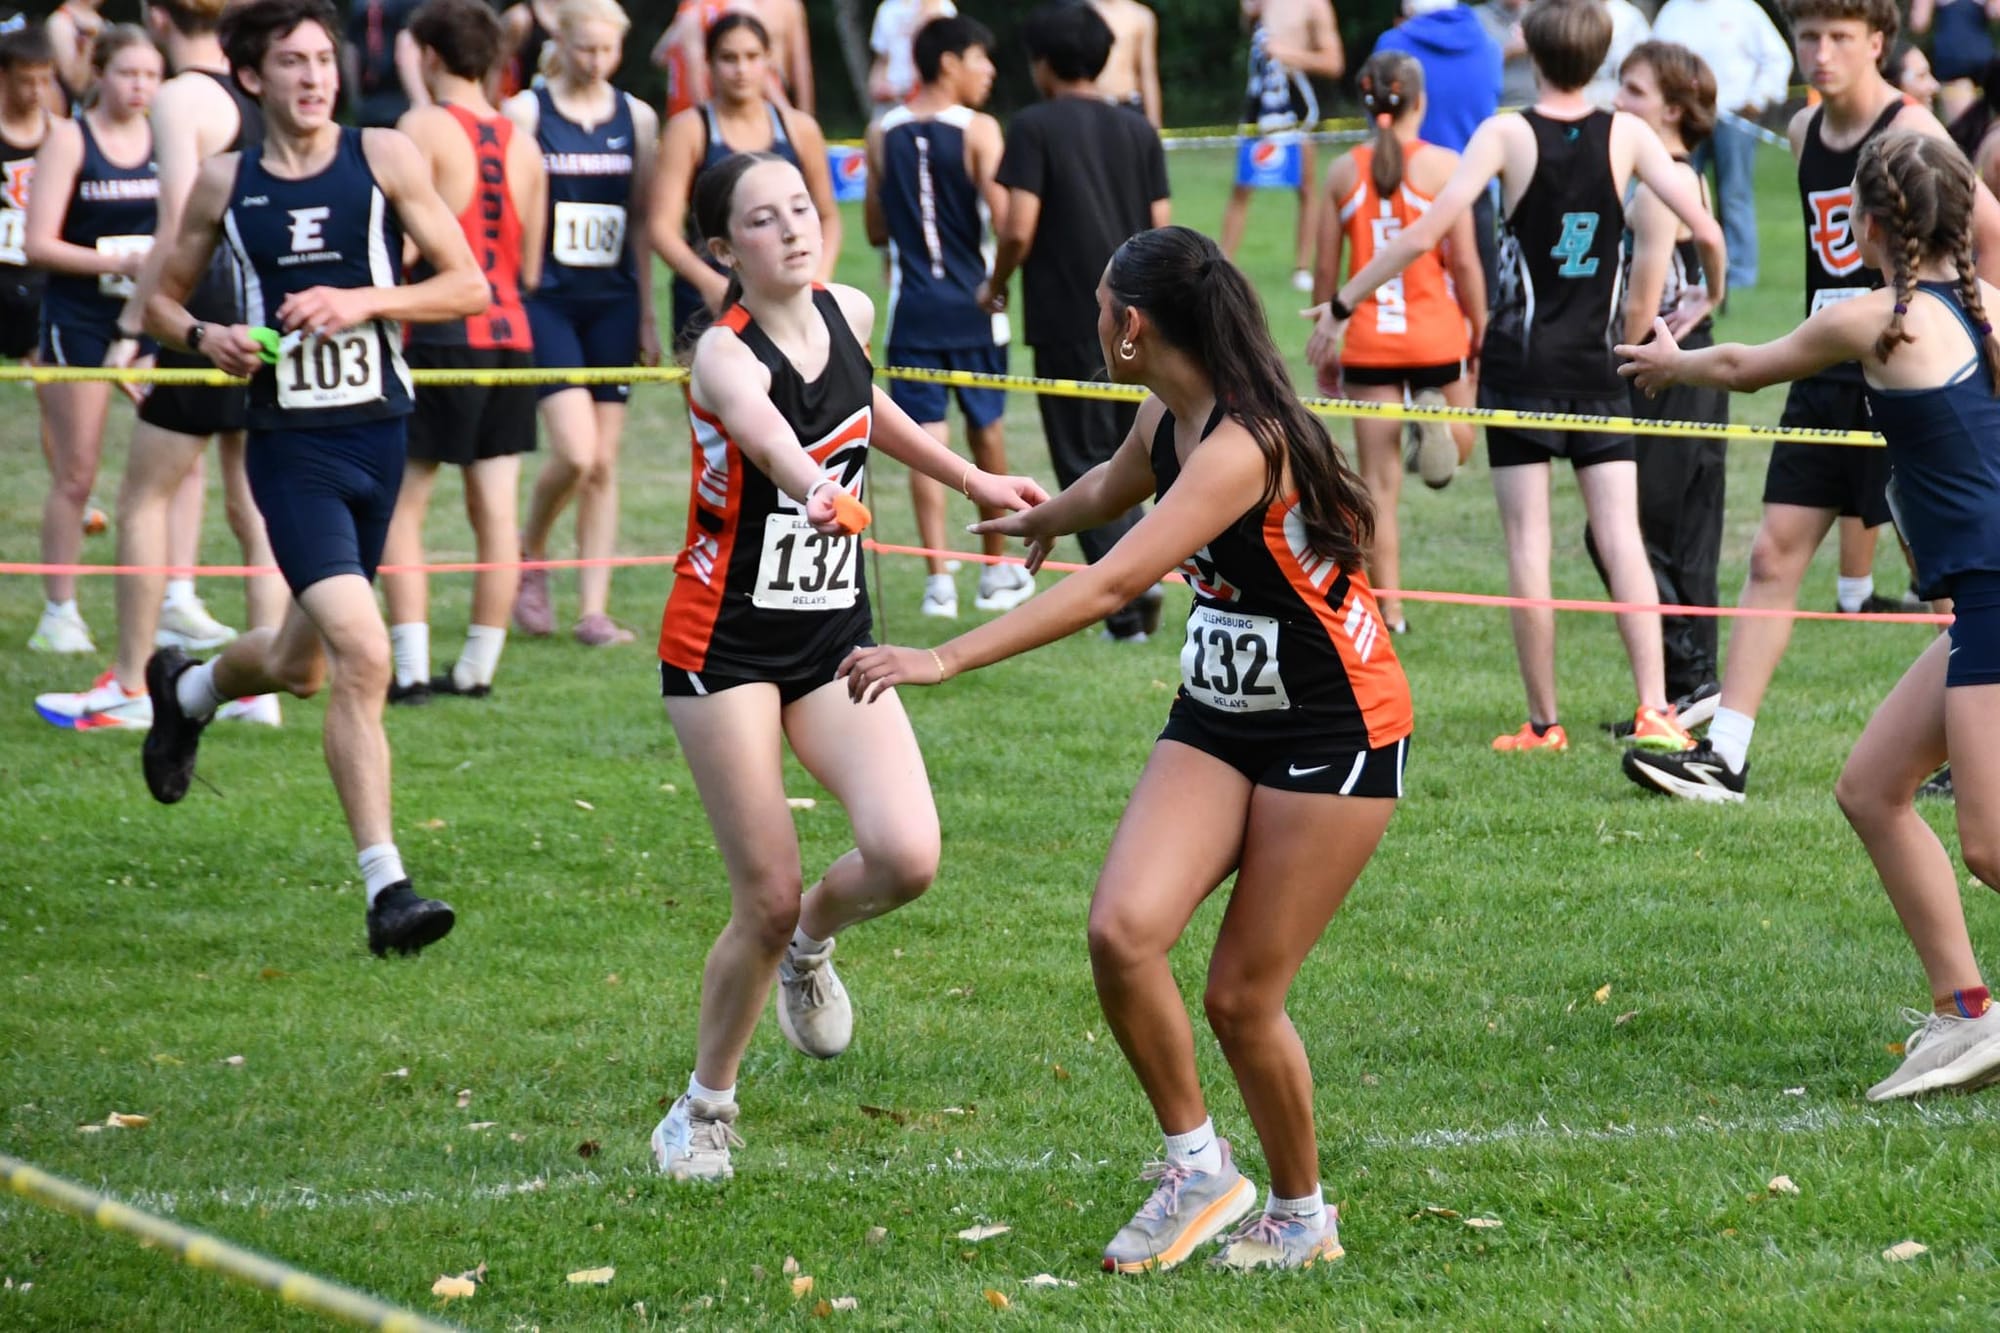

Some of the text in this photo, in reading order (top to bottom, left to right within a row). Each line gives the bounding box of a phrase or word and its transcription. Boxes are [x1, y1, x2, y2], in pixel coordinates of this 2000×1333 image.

[287, 206, 330, 252] E
[286, 336, 371, 391] 103
[768, 533, 852, 592] 132
[792, 596, 827, 605] RELAYS
[1190, 626, 1277, 695] 132
[1213, 696, 1248, 708] RELAYS
